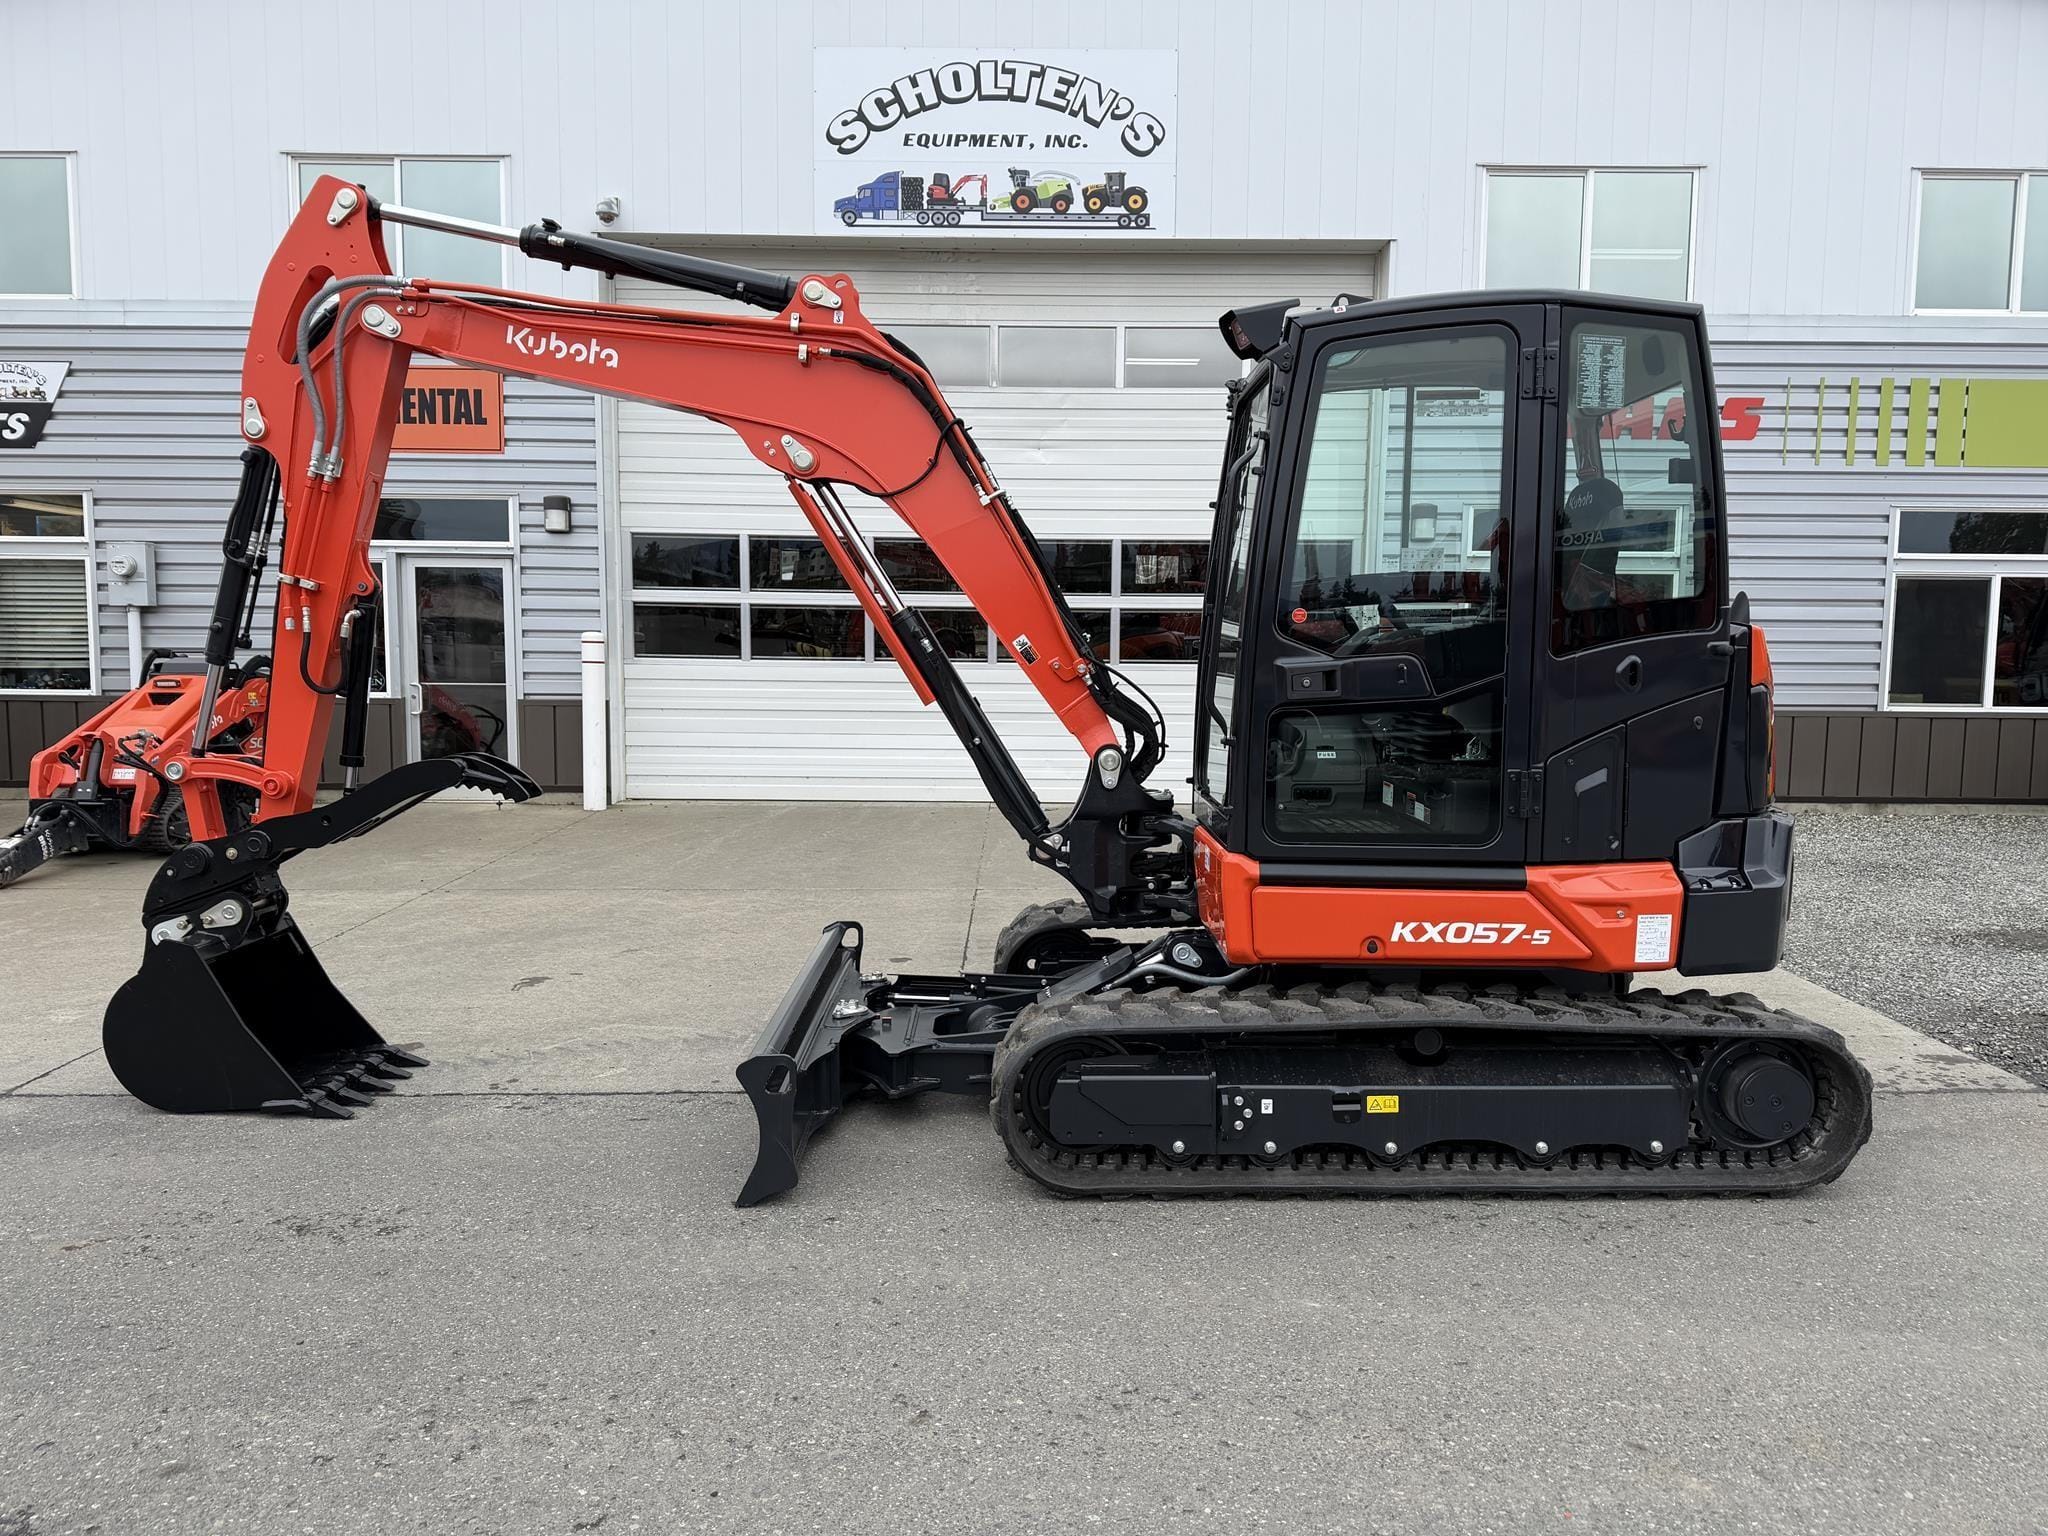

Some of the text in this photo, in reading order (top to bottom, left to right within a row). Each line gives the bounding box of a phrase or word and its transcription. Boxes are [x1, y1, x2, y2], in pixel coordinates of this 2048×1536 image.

[826, 60, 1166, 157] SCHOLTEN'S
[903, 133, 1089, 150] EQUIPMENT, INC.
[506, 325, 619, 368] Kubota
[397, 388, 487, 425] ENTAL
